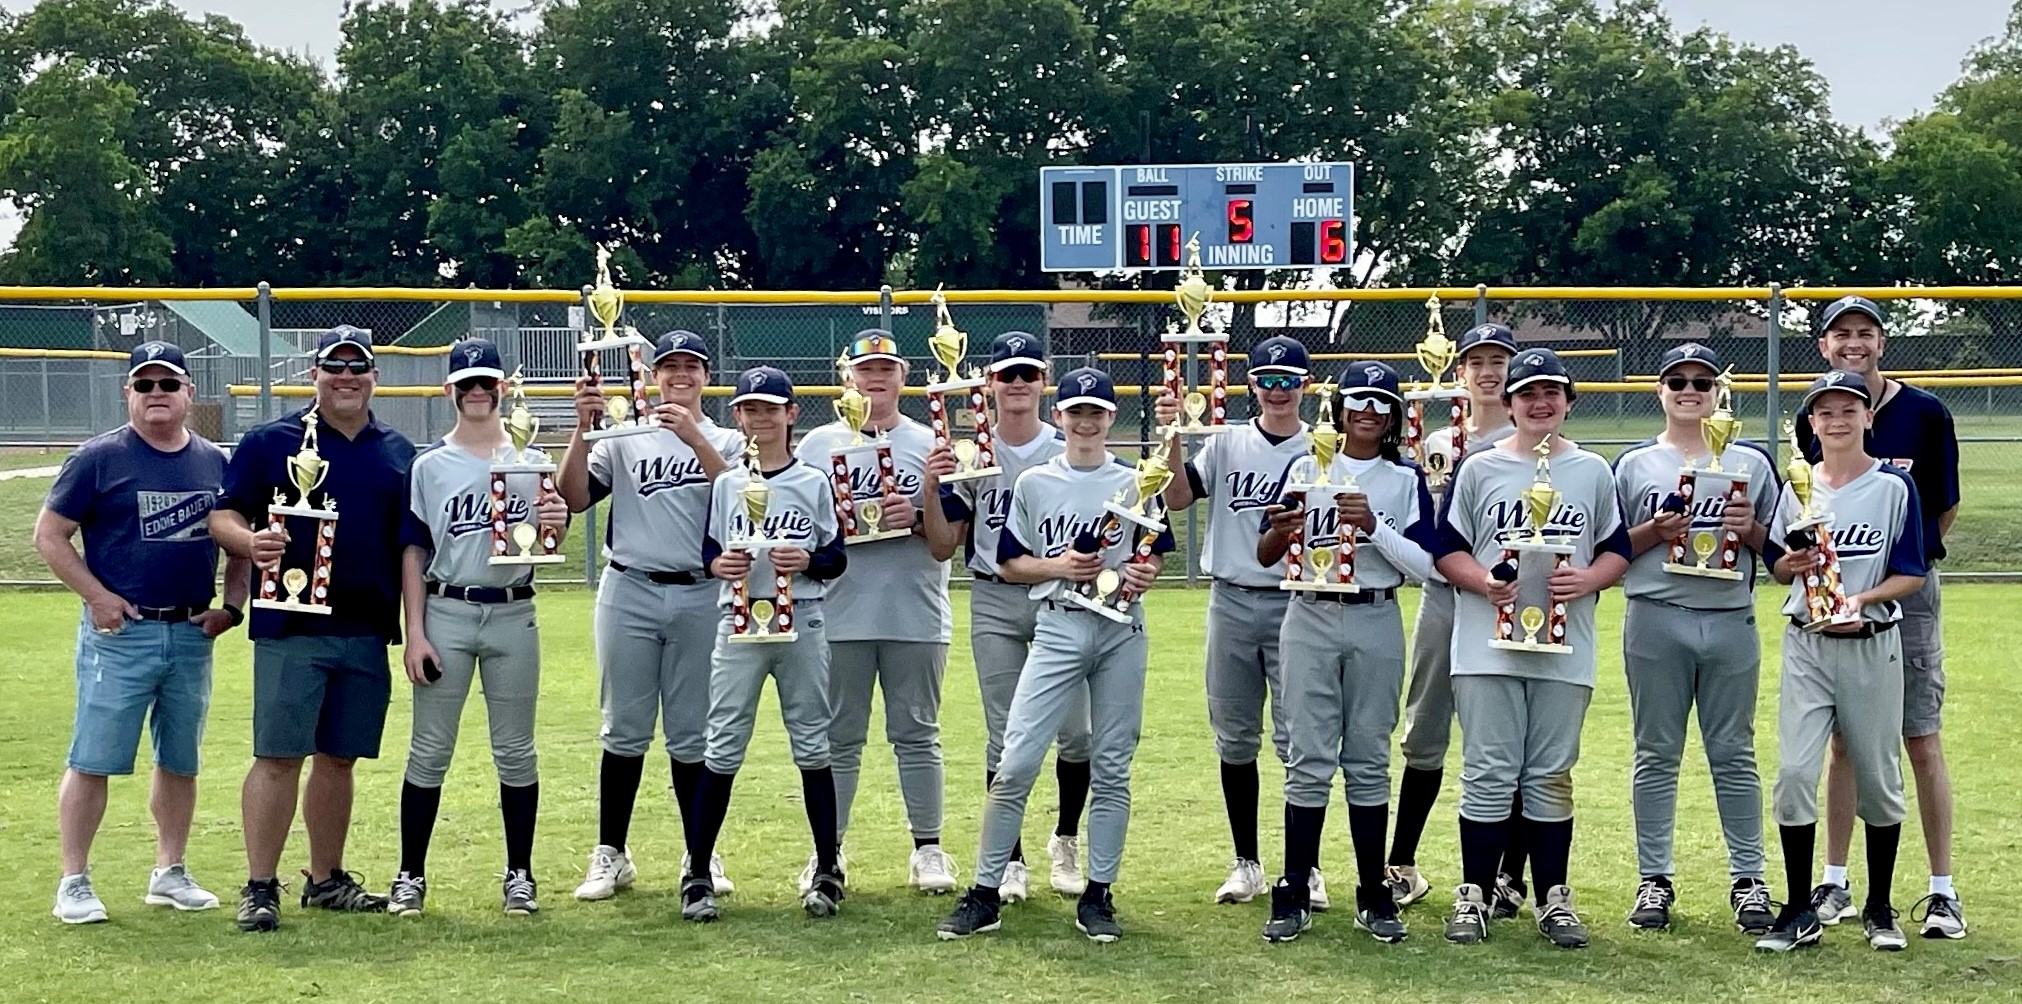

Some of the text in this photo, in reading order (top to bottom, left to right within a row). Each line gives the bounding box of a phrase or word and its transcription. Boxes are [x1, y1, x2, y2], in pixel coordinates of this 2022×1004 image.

[1137, 165, 1333, 183] BALL STRIKE OUT
[1124, 198, 1344, 220] GUEST HOME
[1229, 201, 1252, 242] 5
[1058, 225, 1103, 245] TIME
[1321, 220, 1346, 263] 6
[1208, 244, 1274, 265] INNING
[829, 466, 920, 496] Wyie
[145, 495, 212, 537] EDDIE BAUER
[444, 493, 530, 524] Wyie
[1488, 500, 1586, 531] Wlie
